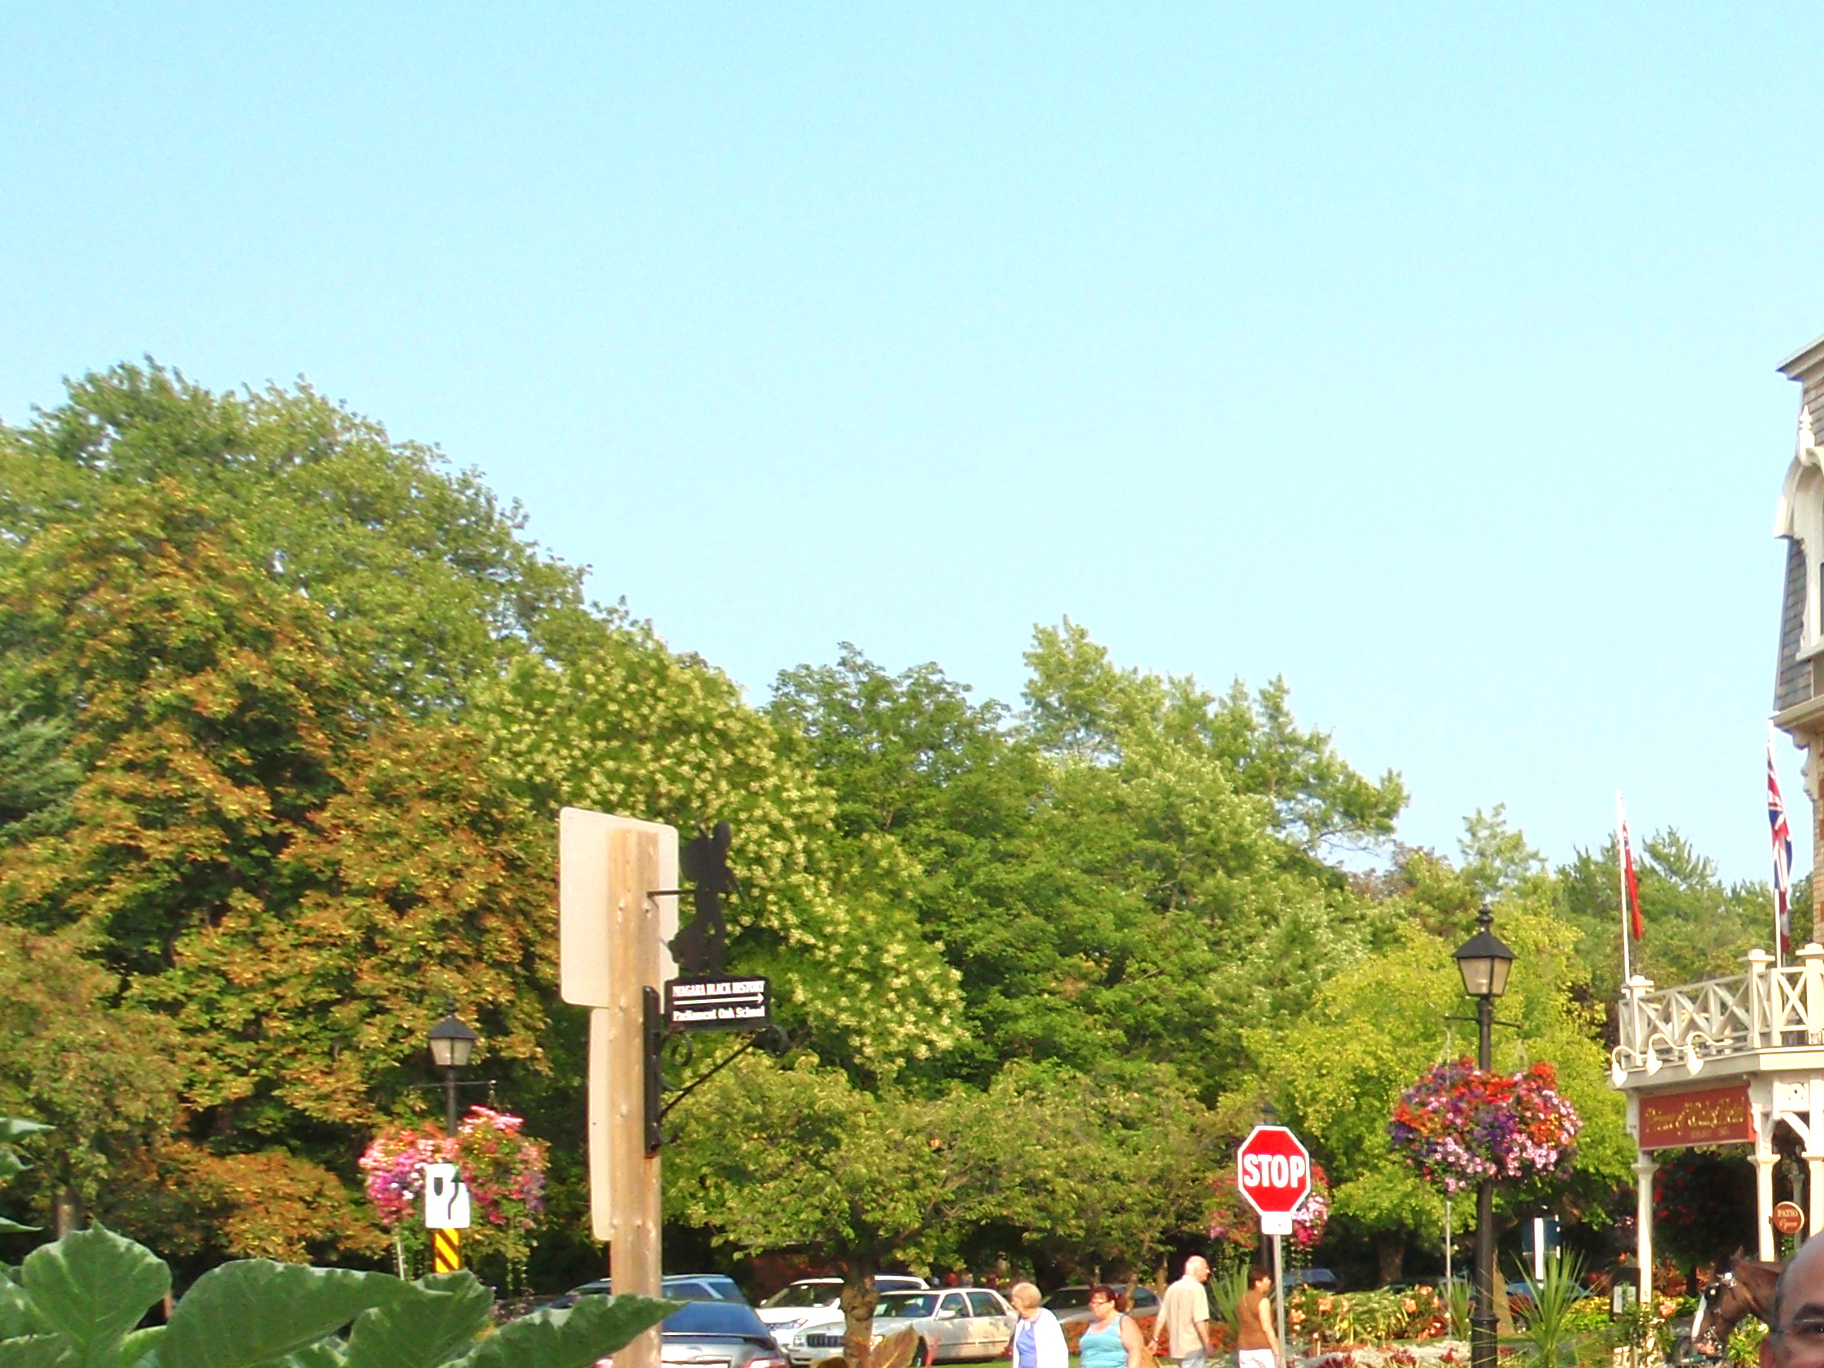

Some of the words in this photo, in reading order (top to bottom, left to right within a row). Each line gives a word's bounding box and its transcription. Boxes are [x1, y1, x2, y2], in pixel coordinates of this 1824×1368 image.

[706, 982, 732, 995] BLACK
[732, 981, 765, 993] HISTORY
[718, 1007, 735, 1019] Oak
[735, 1005, 765, 1018] School
[1243, 1153, 1305, 1188] STOP
[1777, 1209, 1799, 1217] PATIO
